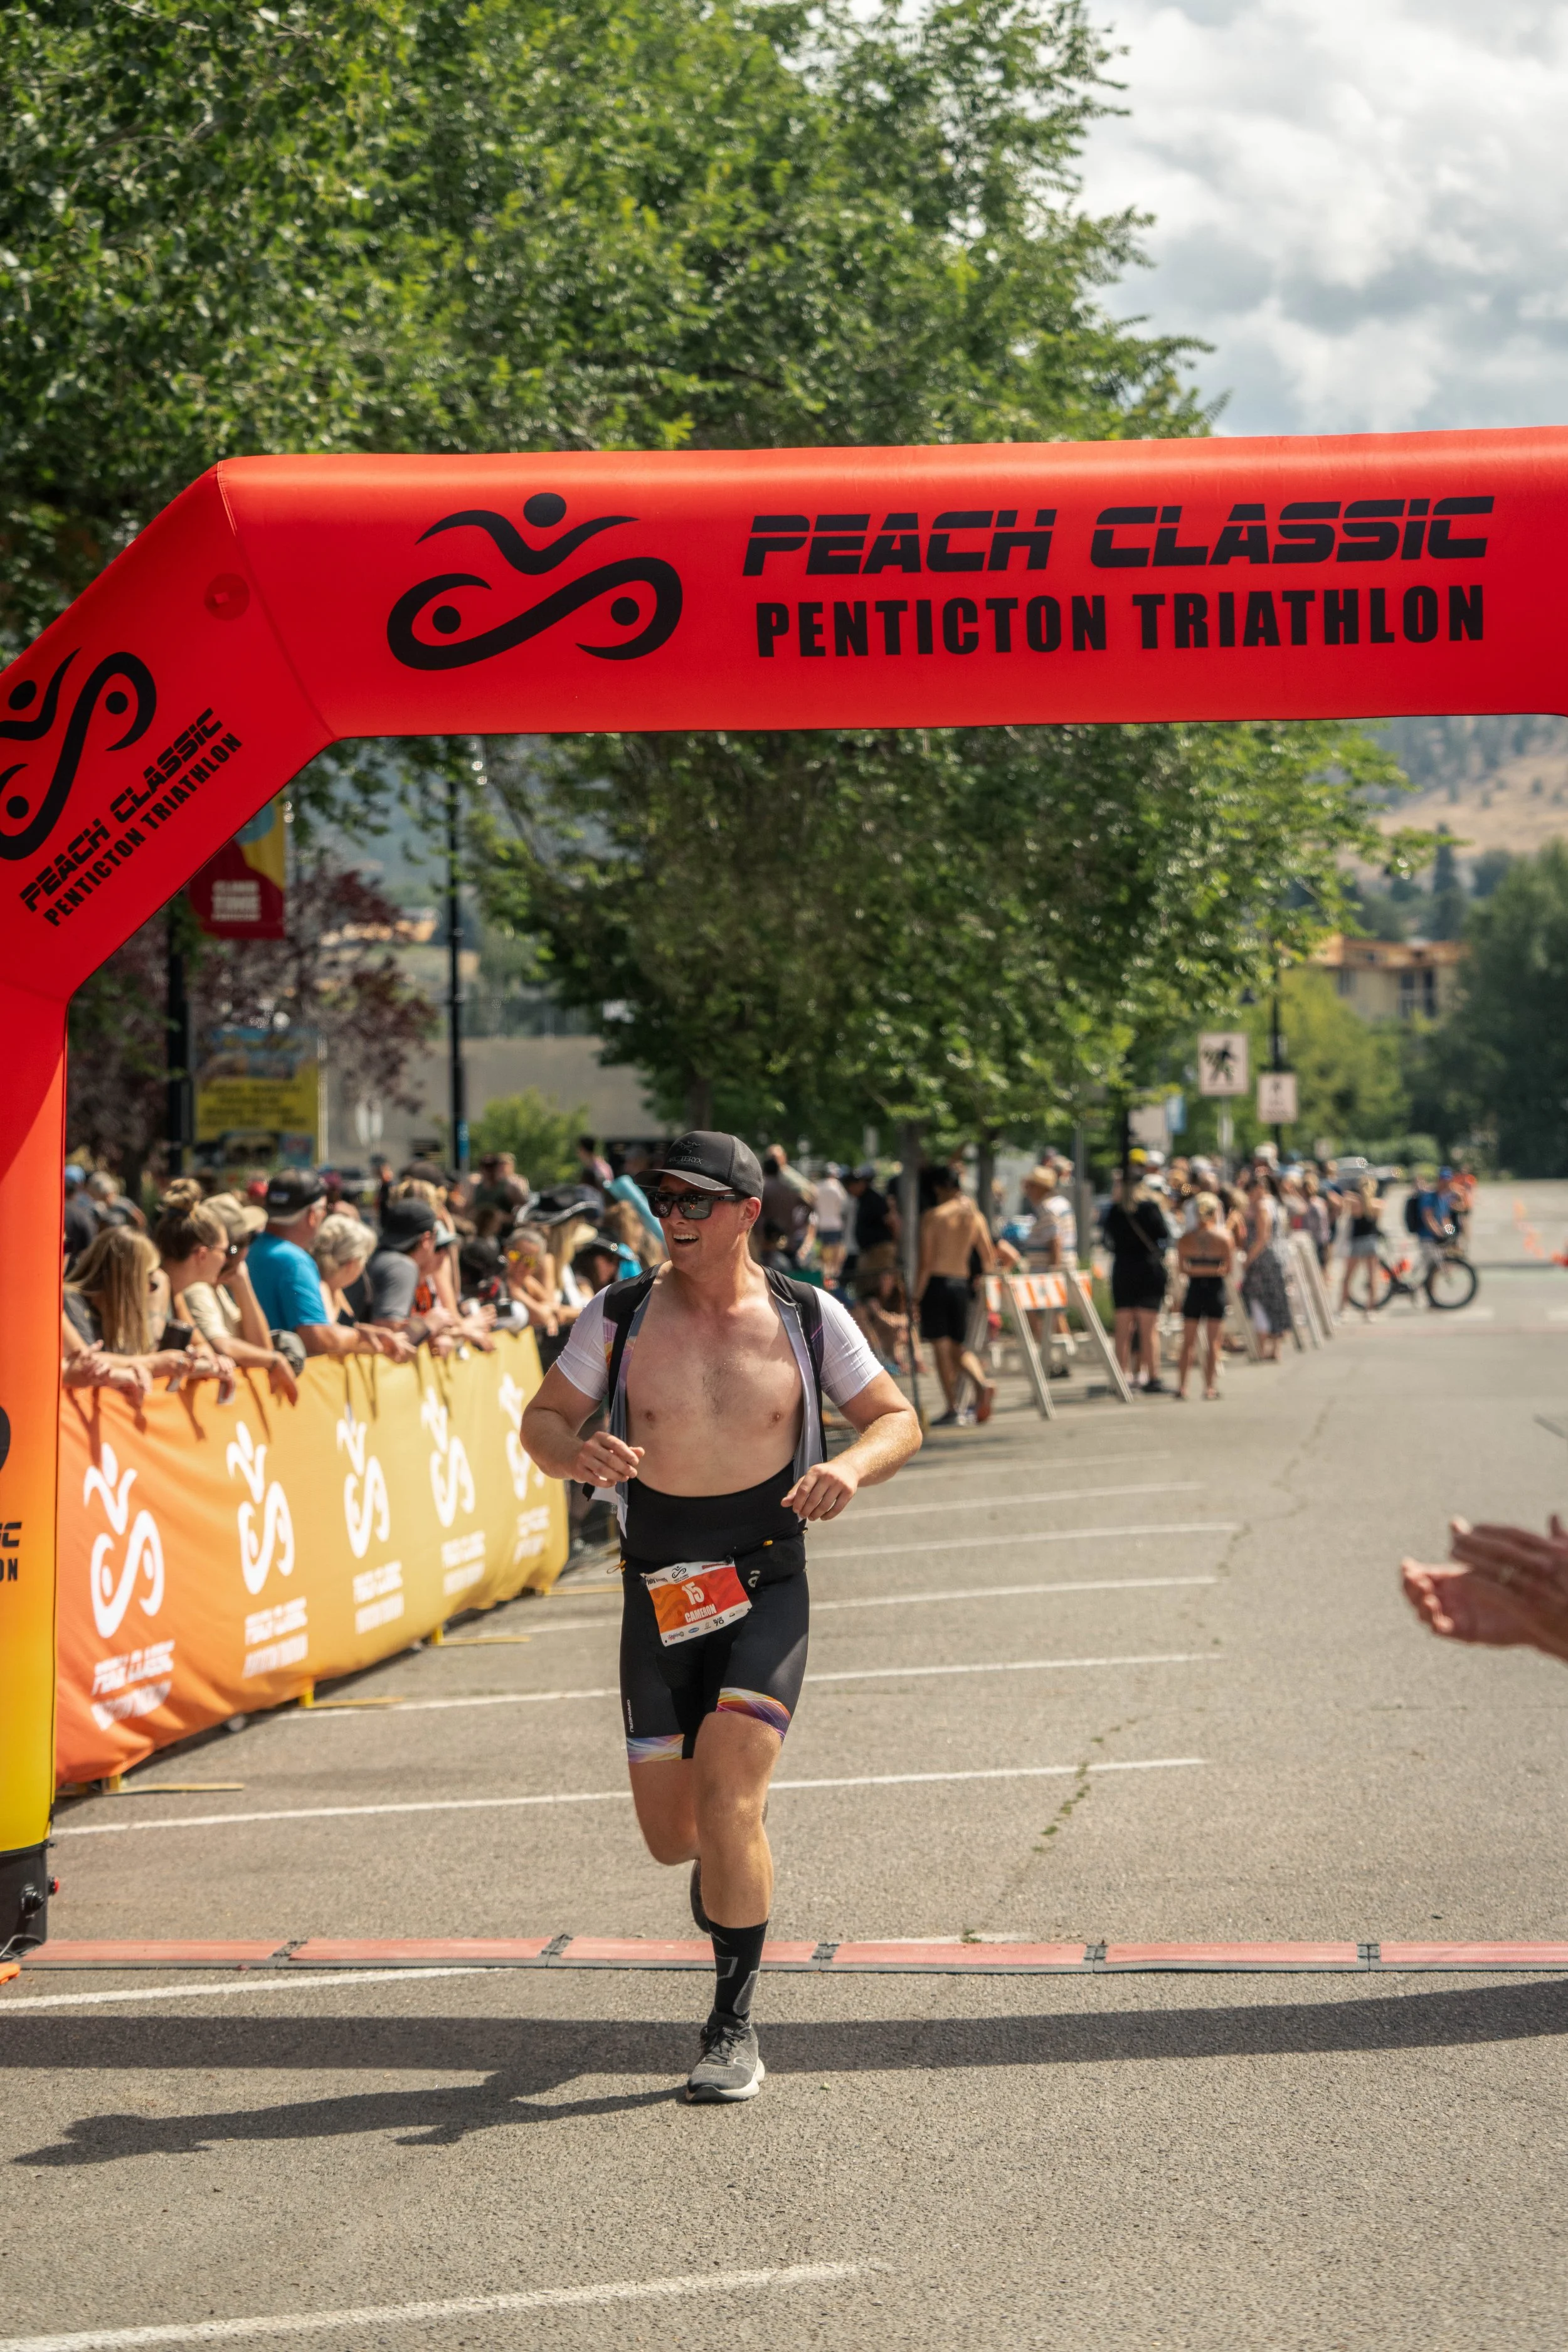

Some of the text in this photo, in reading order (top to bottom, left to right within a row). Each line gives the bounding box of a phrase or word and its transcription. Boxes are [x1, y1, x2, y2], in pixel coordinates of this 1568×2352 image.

[743, 495, 1495, 576] PEACH CLASSIC
[756, 584, 1484, 658] PENTICTON TRIATHLON
[19, 707, 223, 913] PEACH CLASSIC
[43, 827, 147, 927] PENTICTON
[140, 733, 243, 830] TRIATHLON
[682, 1581, 704, 1605] 15
[684, 1603, 717, 1623] CAMERON
